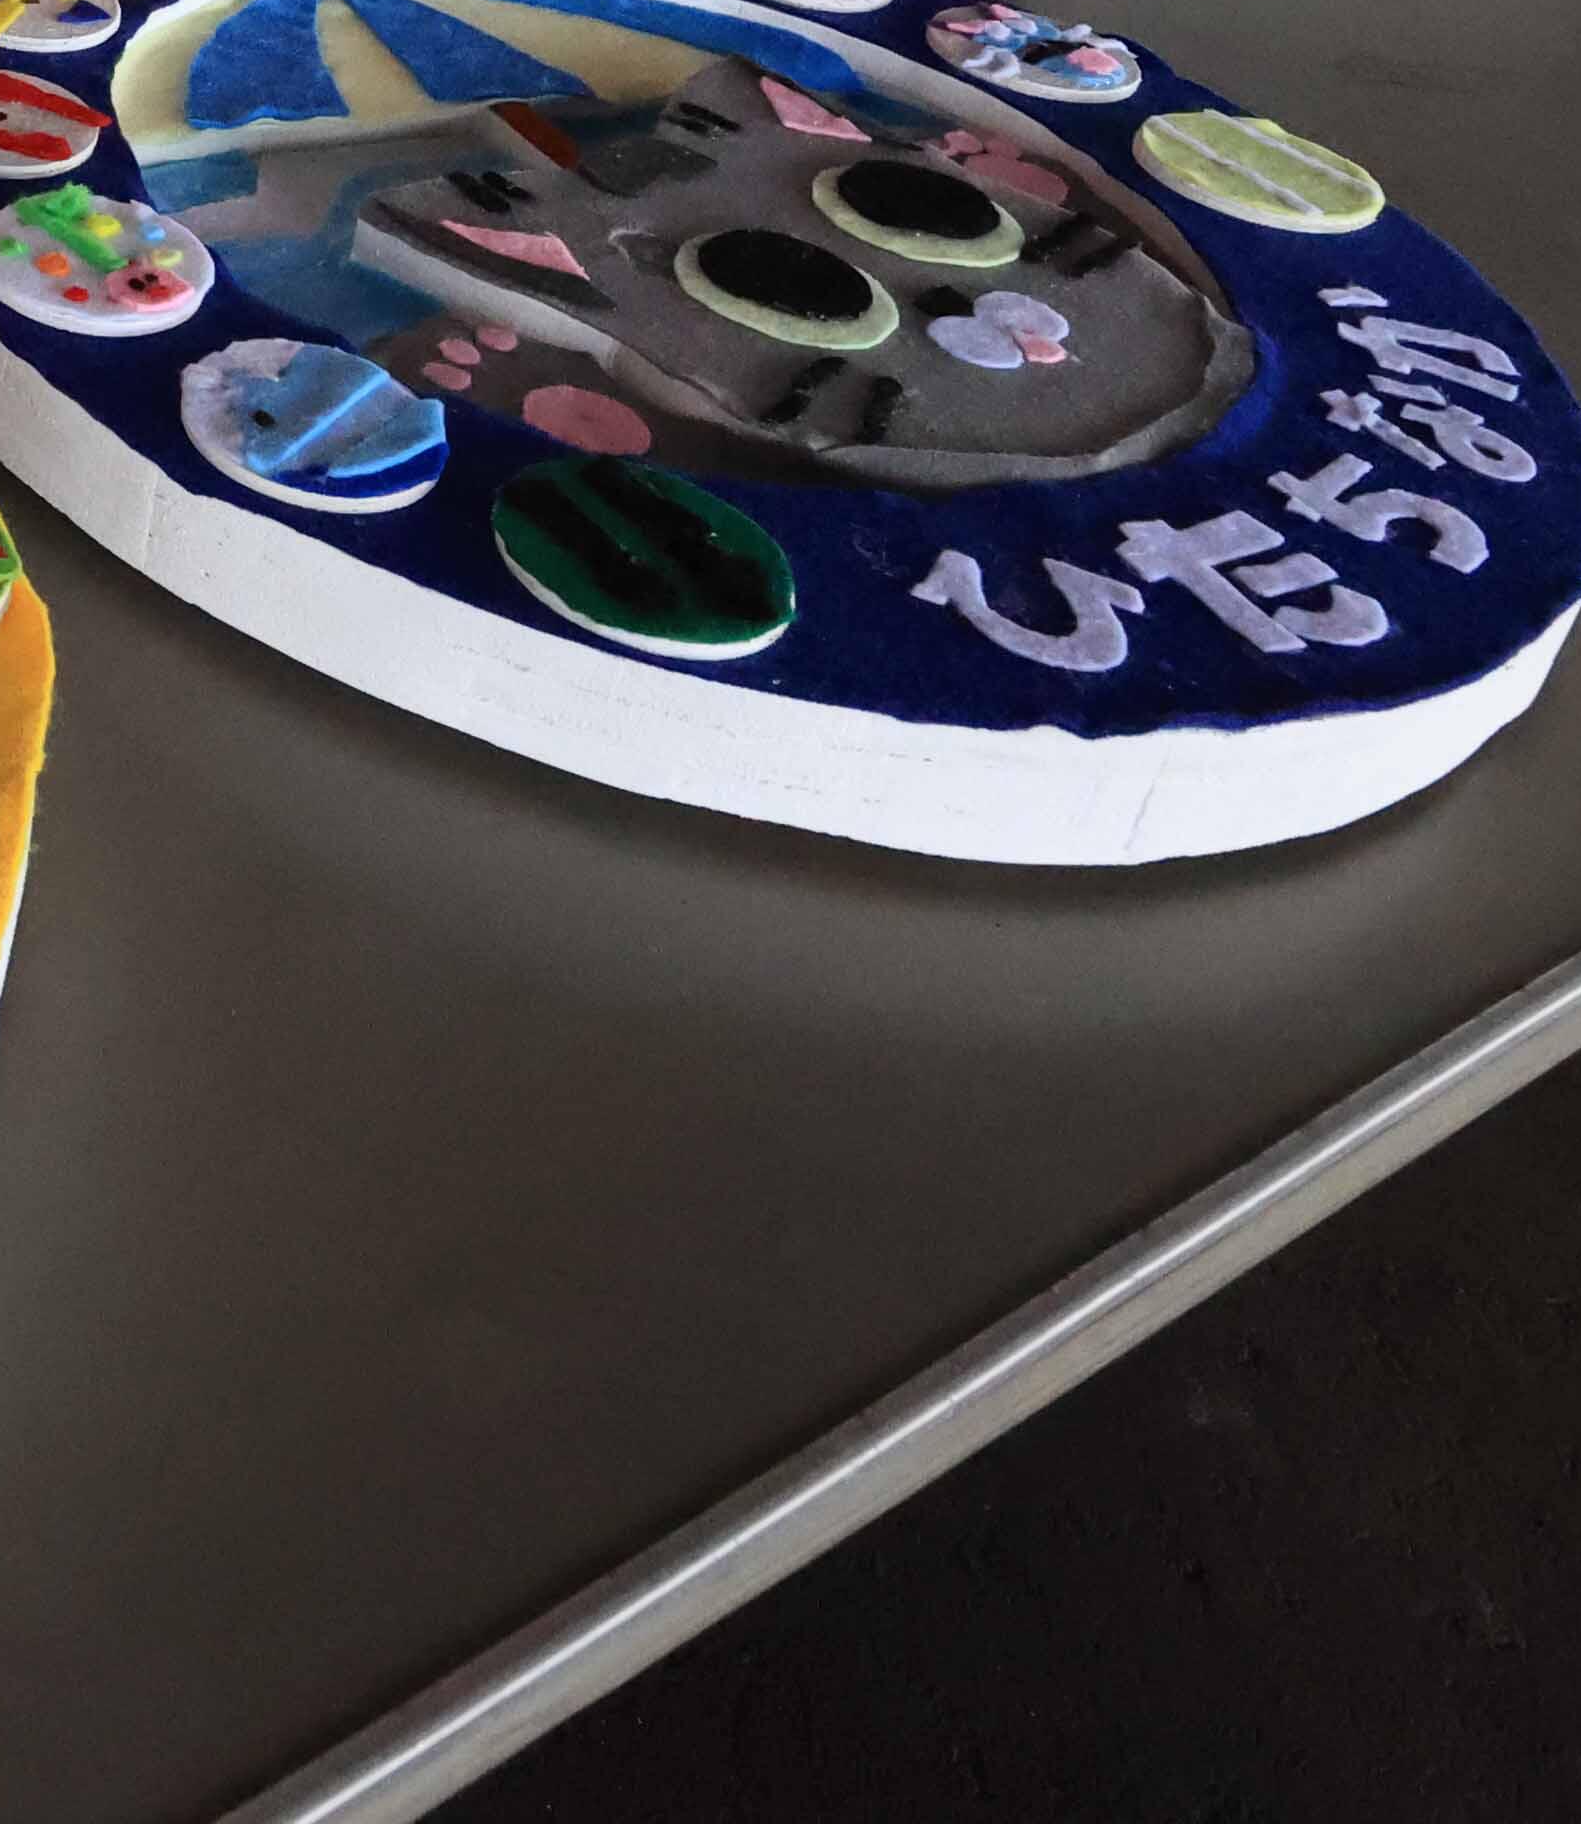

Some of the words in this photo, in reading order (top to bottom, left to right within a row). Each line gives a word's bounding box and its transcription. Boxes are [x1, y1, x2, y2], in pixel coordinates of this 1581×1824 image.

[911, 285, 1540, 675] ひたちなか
